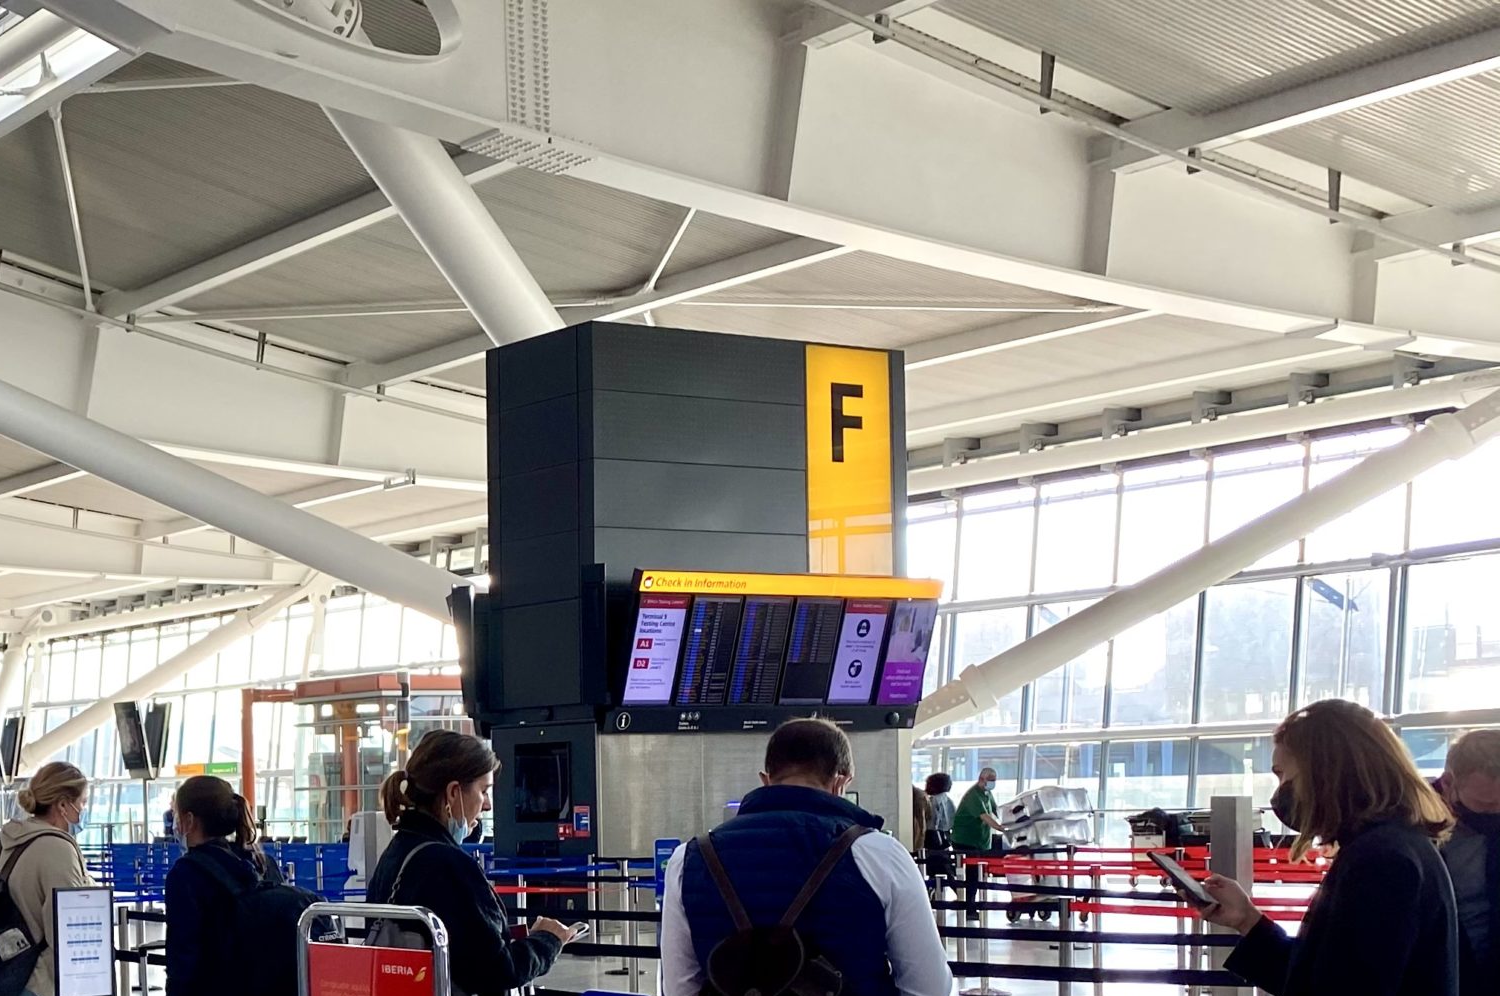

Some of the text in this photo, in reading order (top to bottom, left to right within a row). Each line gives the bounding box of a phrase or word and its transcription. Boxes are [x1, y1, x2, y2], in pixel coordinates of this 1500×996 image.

[831, 382, 863, 462] F
[655, 577, 681, 588] Check
[636, 660, 646, 668] D2
[381, 964, 414, 976] IBERIA
